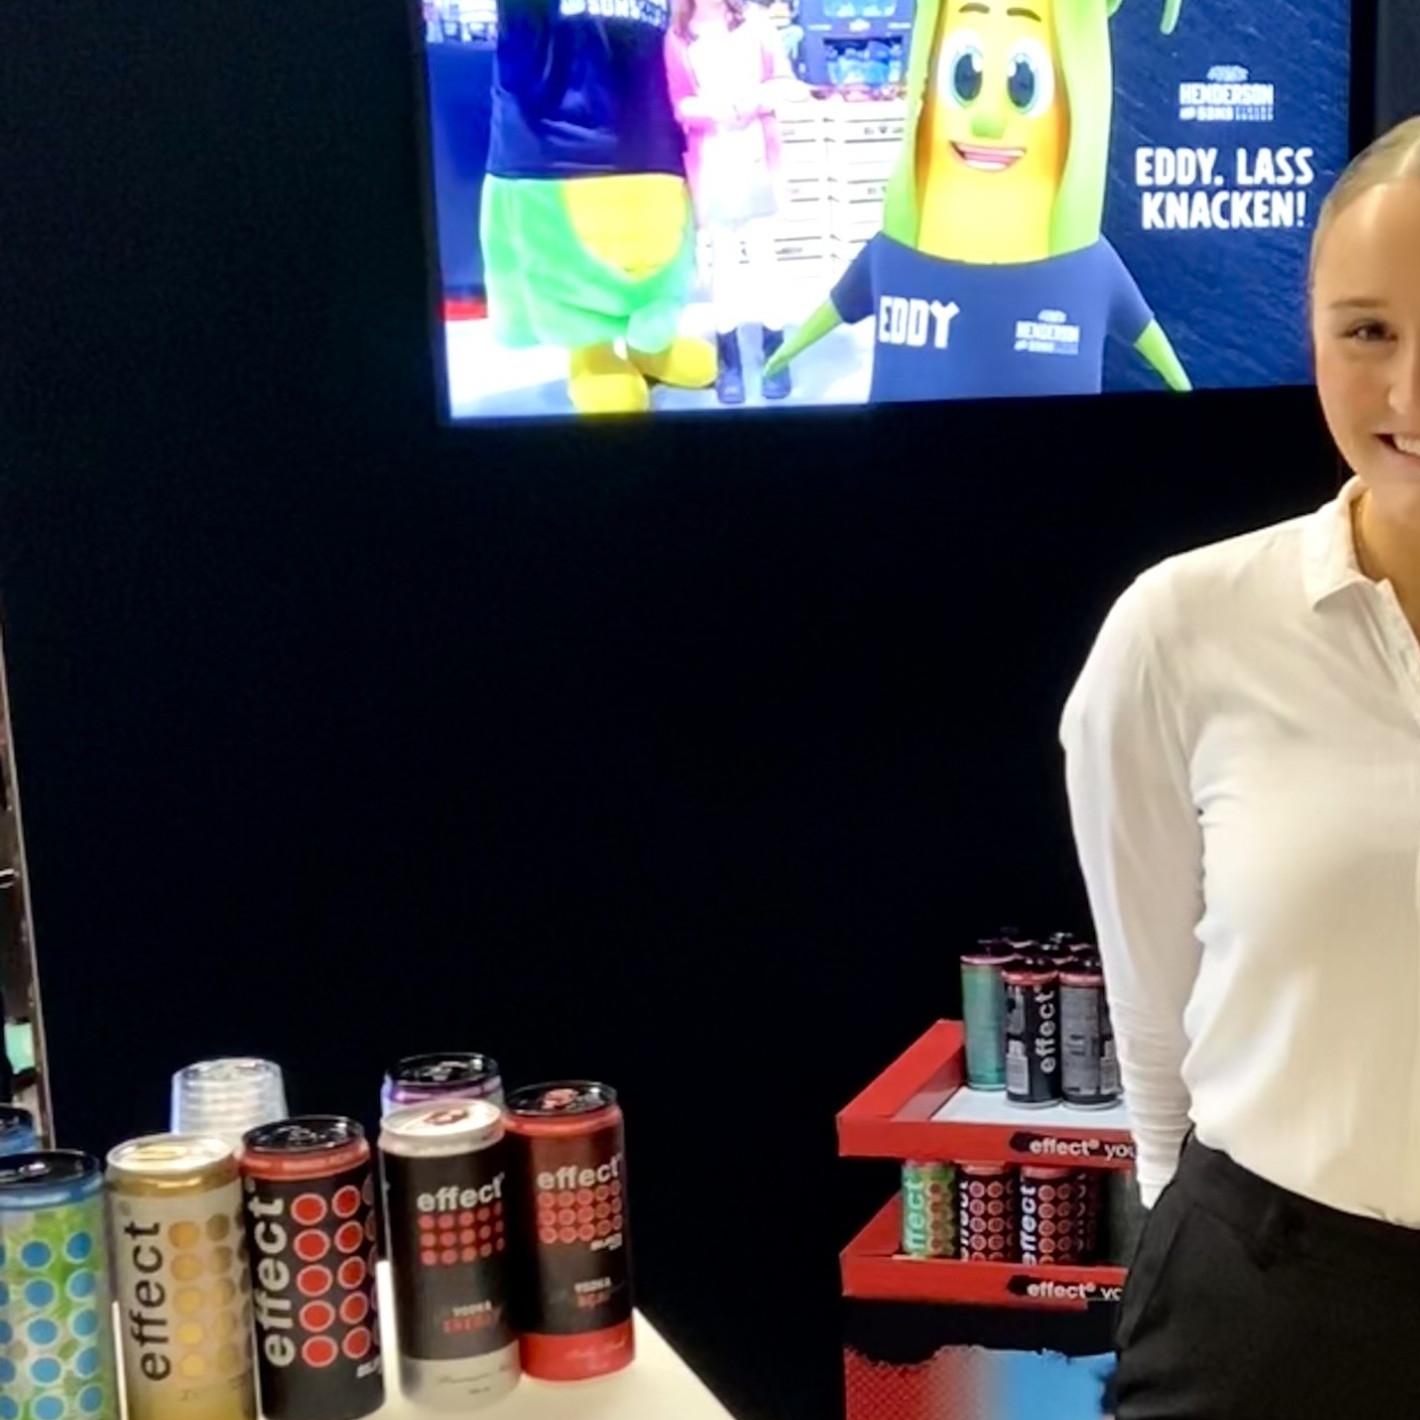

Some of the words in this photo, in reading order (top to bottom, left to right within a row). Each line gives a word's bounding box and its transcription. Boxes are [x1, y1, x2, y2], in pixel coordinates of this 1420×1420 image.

[1135, 147, 1224, 187] EDDY.
[1236, 147, 1315, 186] LASS
[1141, 190, 1306, 230] KNACKEN!
[879, 295, 960, 349] EDDY
[124, 1221, 171, 1382] effect
